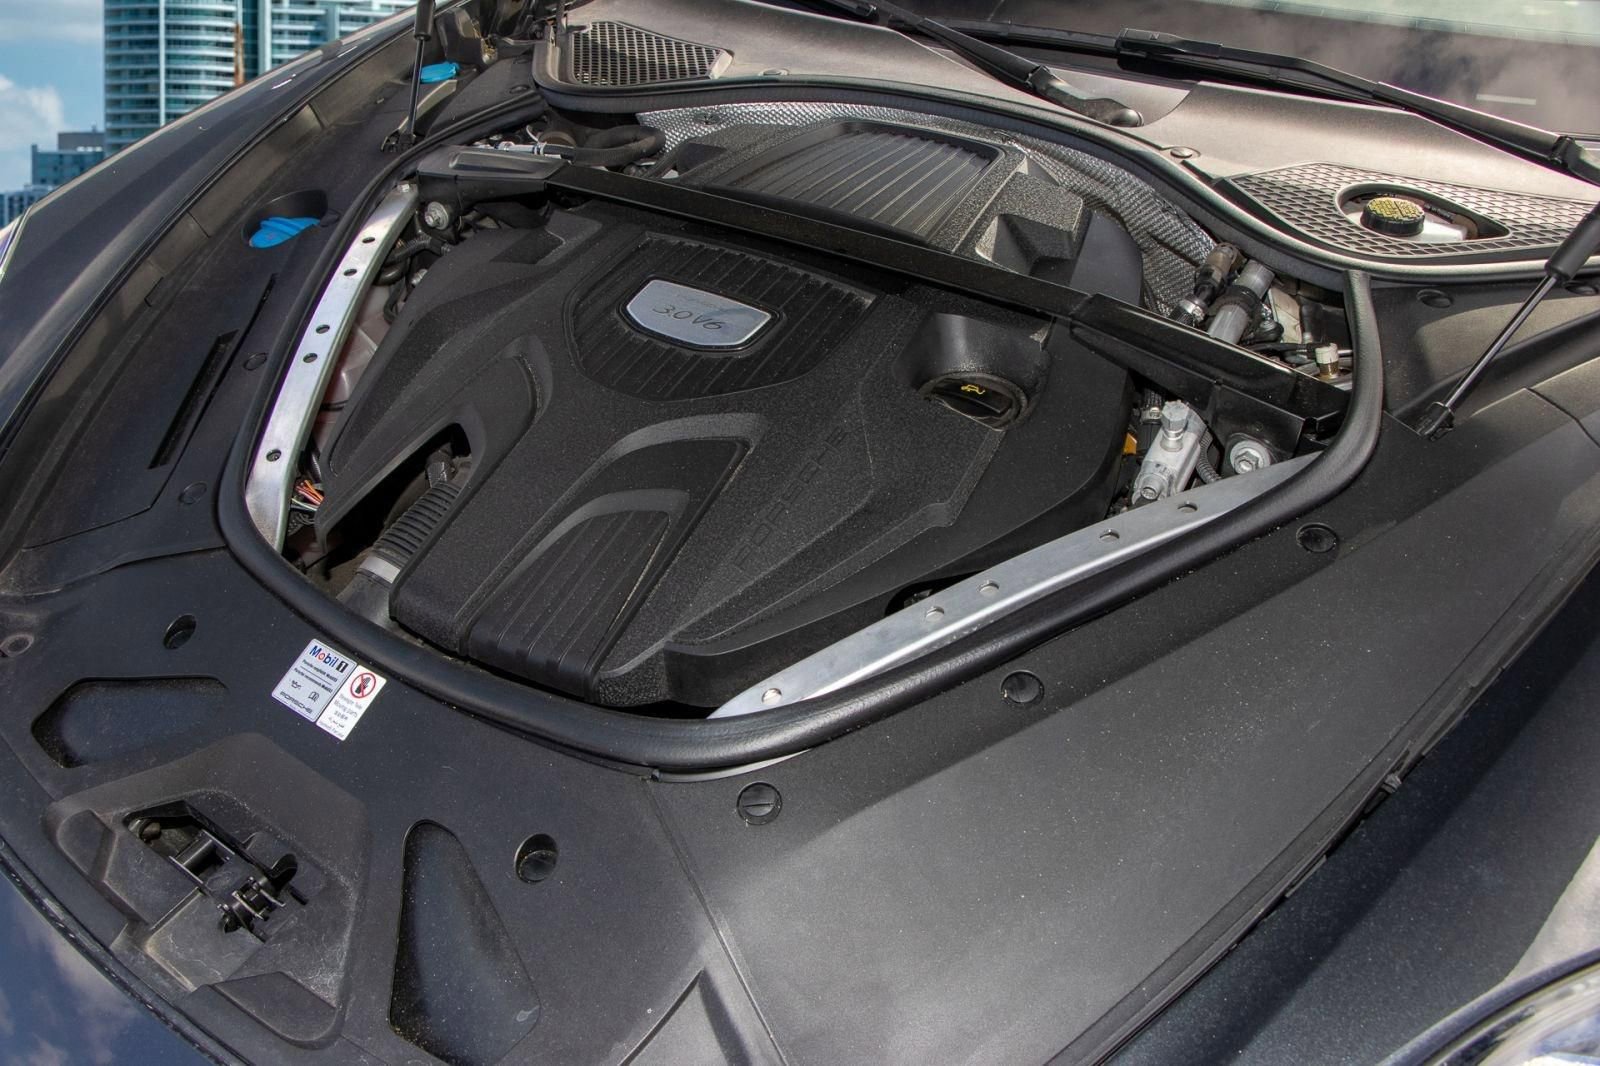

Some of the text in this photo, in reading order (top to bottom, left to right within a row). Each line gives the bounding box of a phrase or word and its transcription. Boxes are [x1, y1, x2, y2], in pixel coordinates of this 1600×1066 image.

[692, 314, 727, 330] V6
[731, 425, 851, 572] PORSCHE
[309, 645, 339, 668] Mobil
[335, 660, 349, 673] 1
[280, 691, 313, 714] PORSCHE
